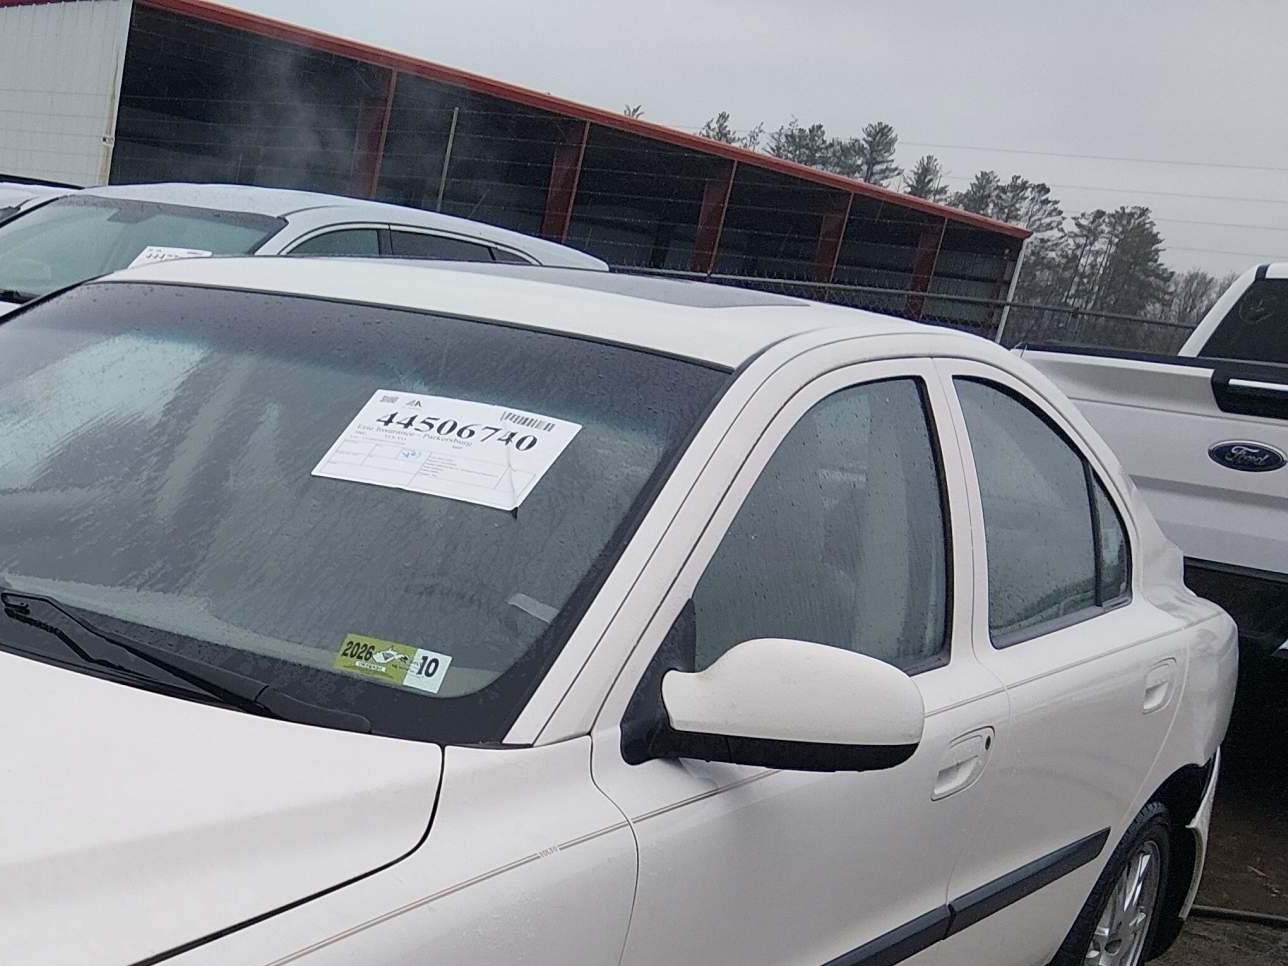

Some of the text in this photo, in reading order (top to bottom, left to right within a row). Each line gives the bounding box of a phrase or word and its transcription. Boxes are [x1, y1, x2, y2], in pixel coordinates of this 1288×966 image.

[376, 411, 538, 452] 44506740
[1225, 445, 1270, 466] Ford
[341, 641, 440, 678] 2026 10
